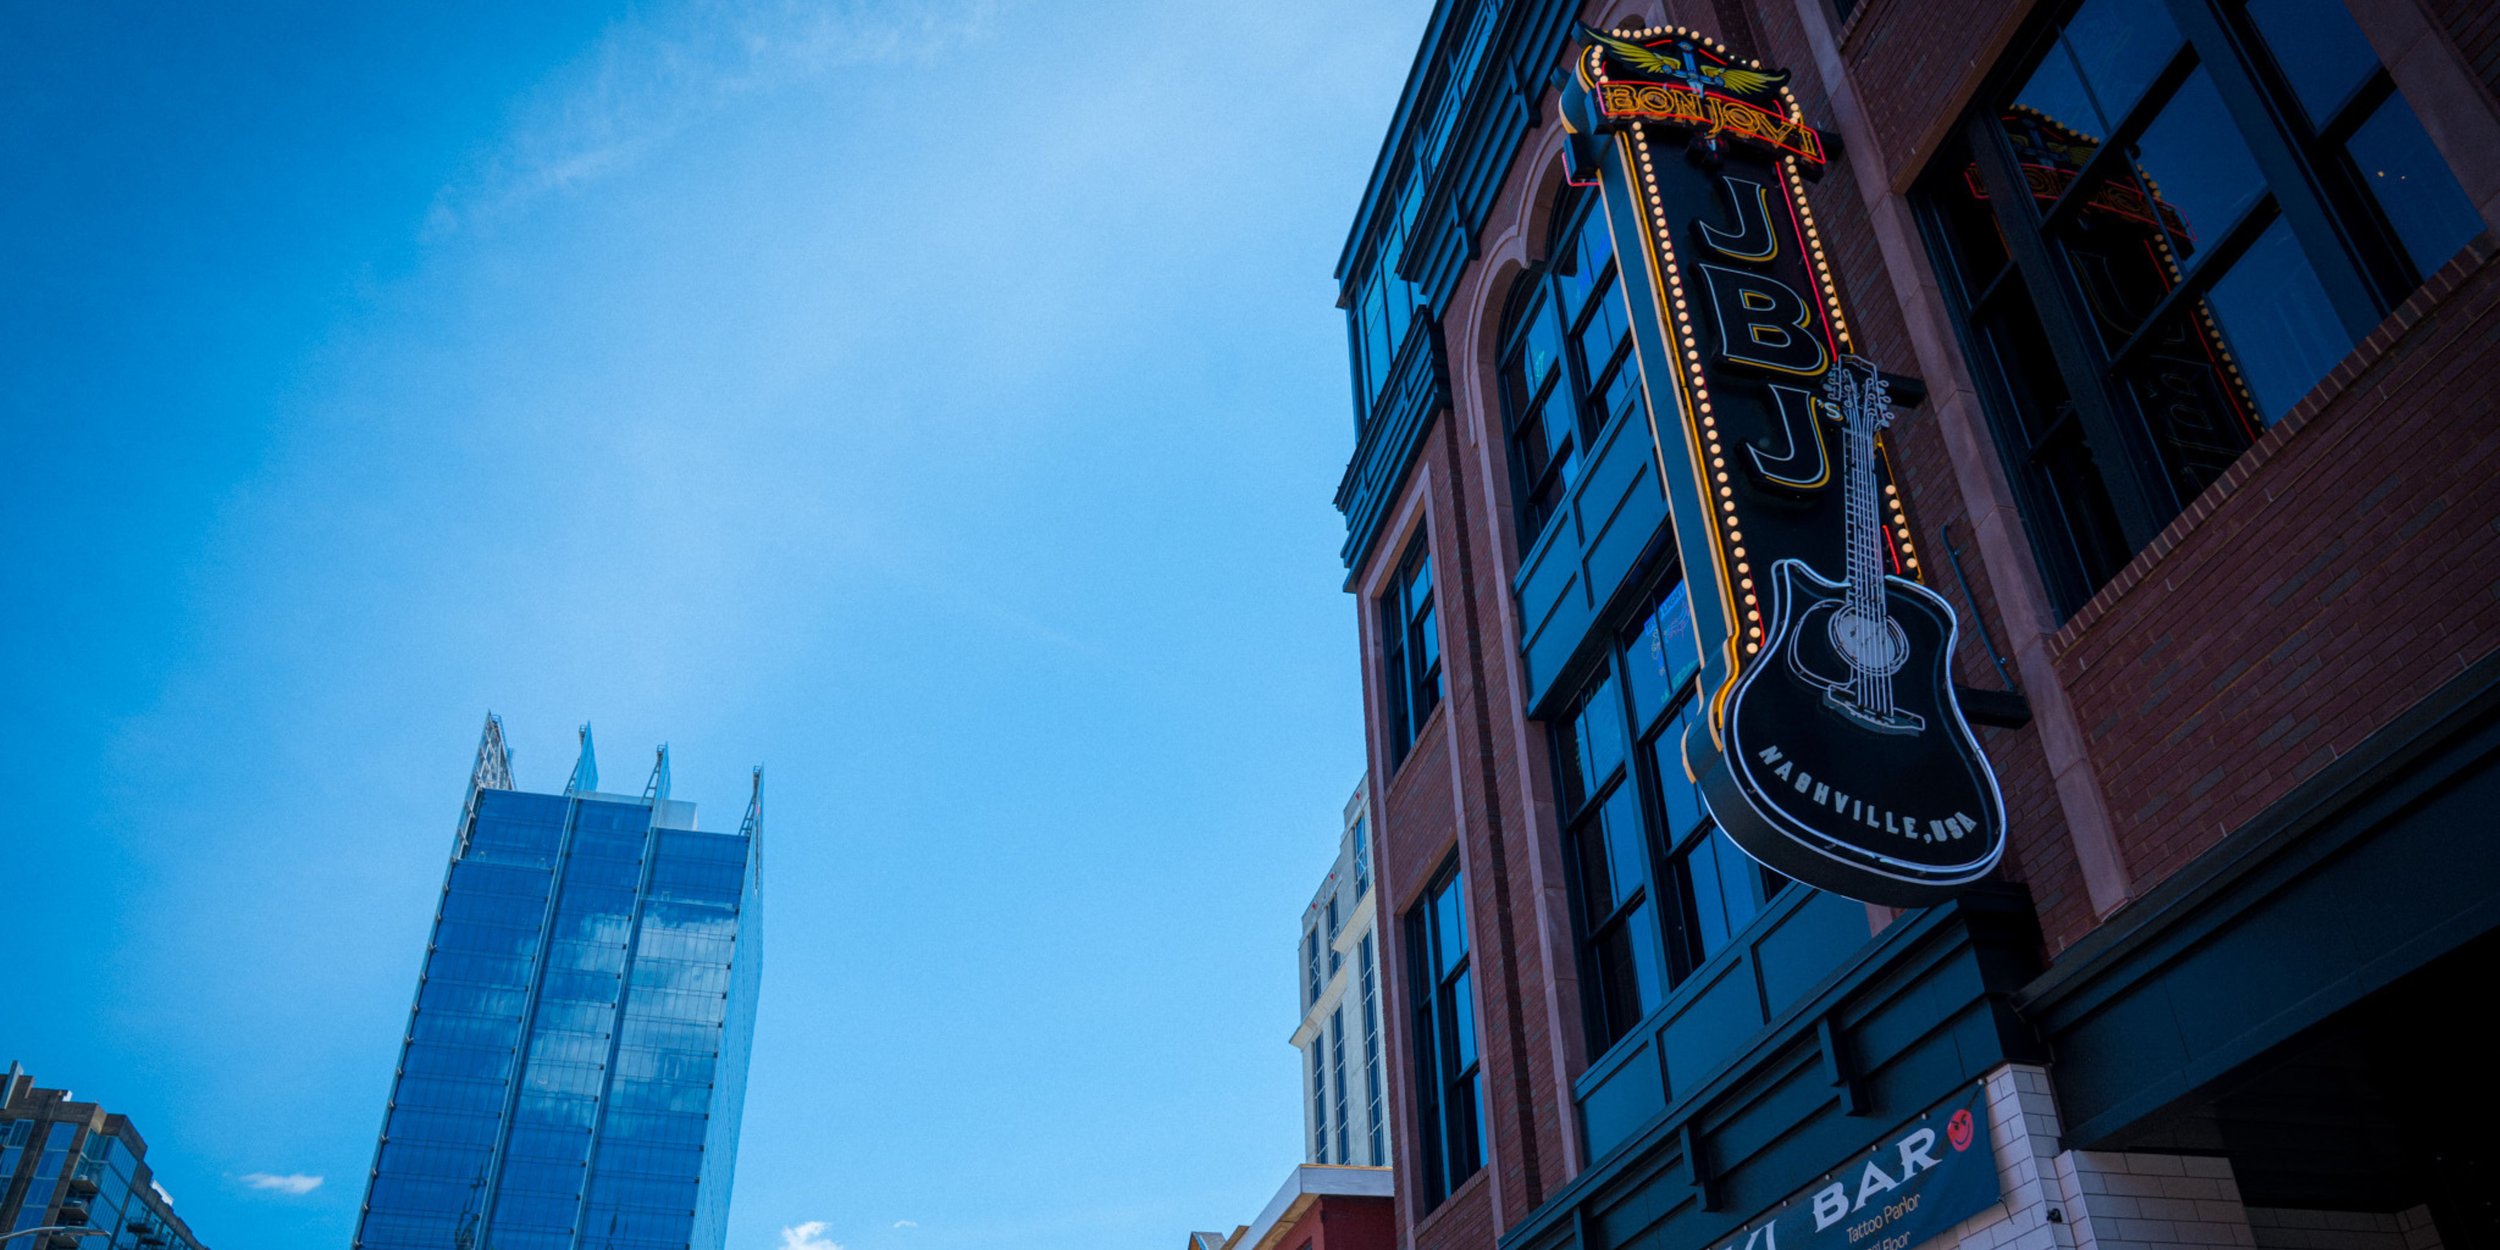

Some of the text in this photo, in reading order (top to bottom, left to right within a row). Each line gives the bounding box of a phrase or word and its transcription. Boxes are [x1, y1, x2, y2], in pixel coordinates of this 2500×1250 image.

[1602, 84, 1818, 157] BON JOVI
[1812, 1127, 1943, 1233] BAR
[1846, 1193, 1921, 1244] Tattoo Parlor
[1882, 1231, 1911, 1250] Floor
